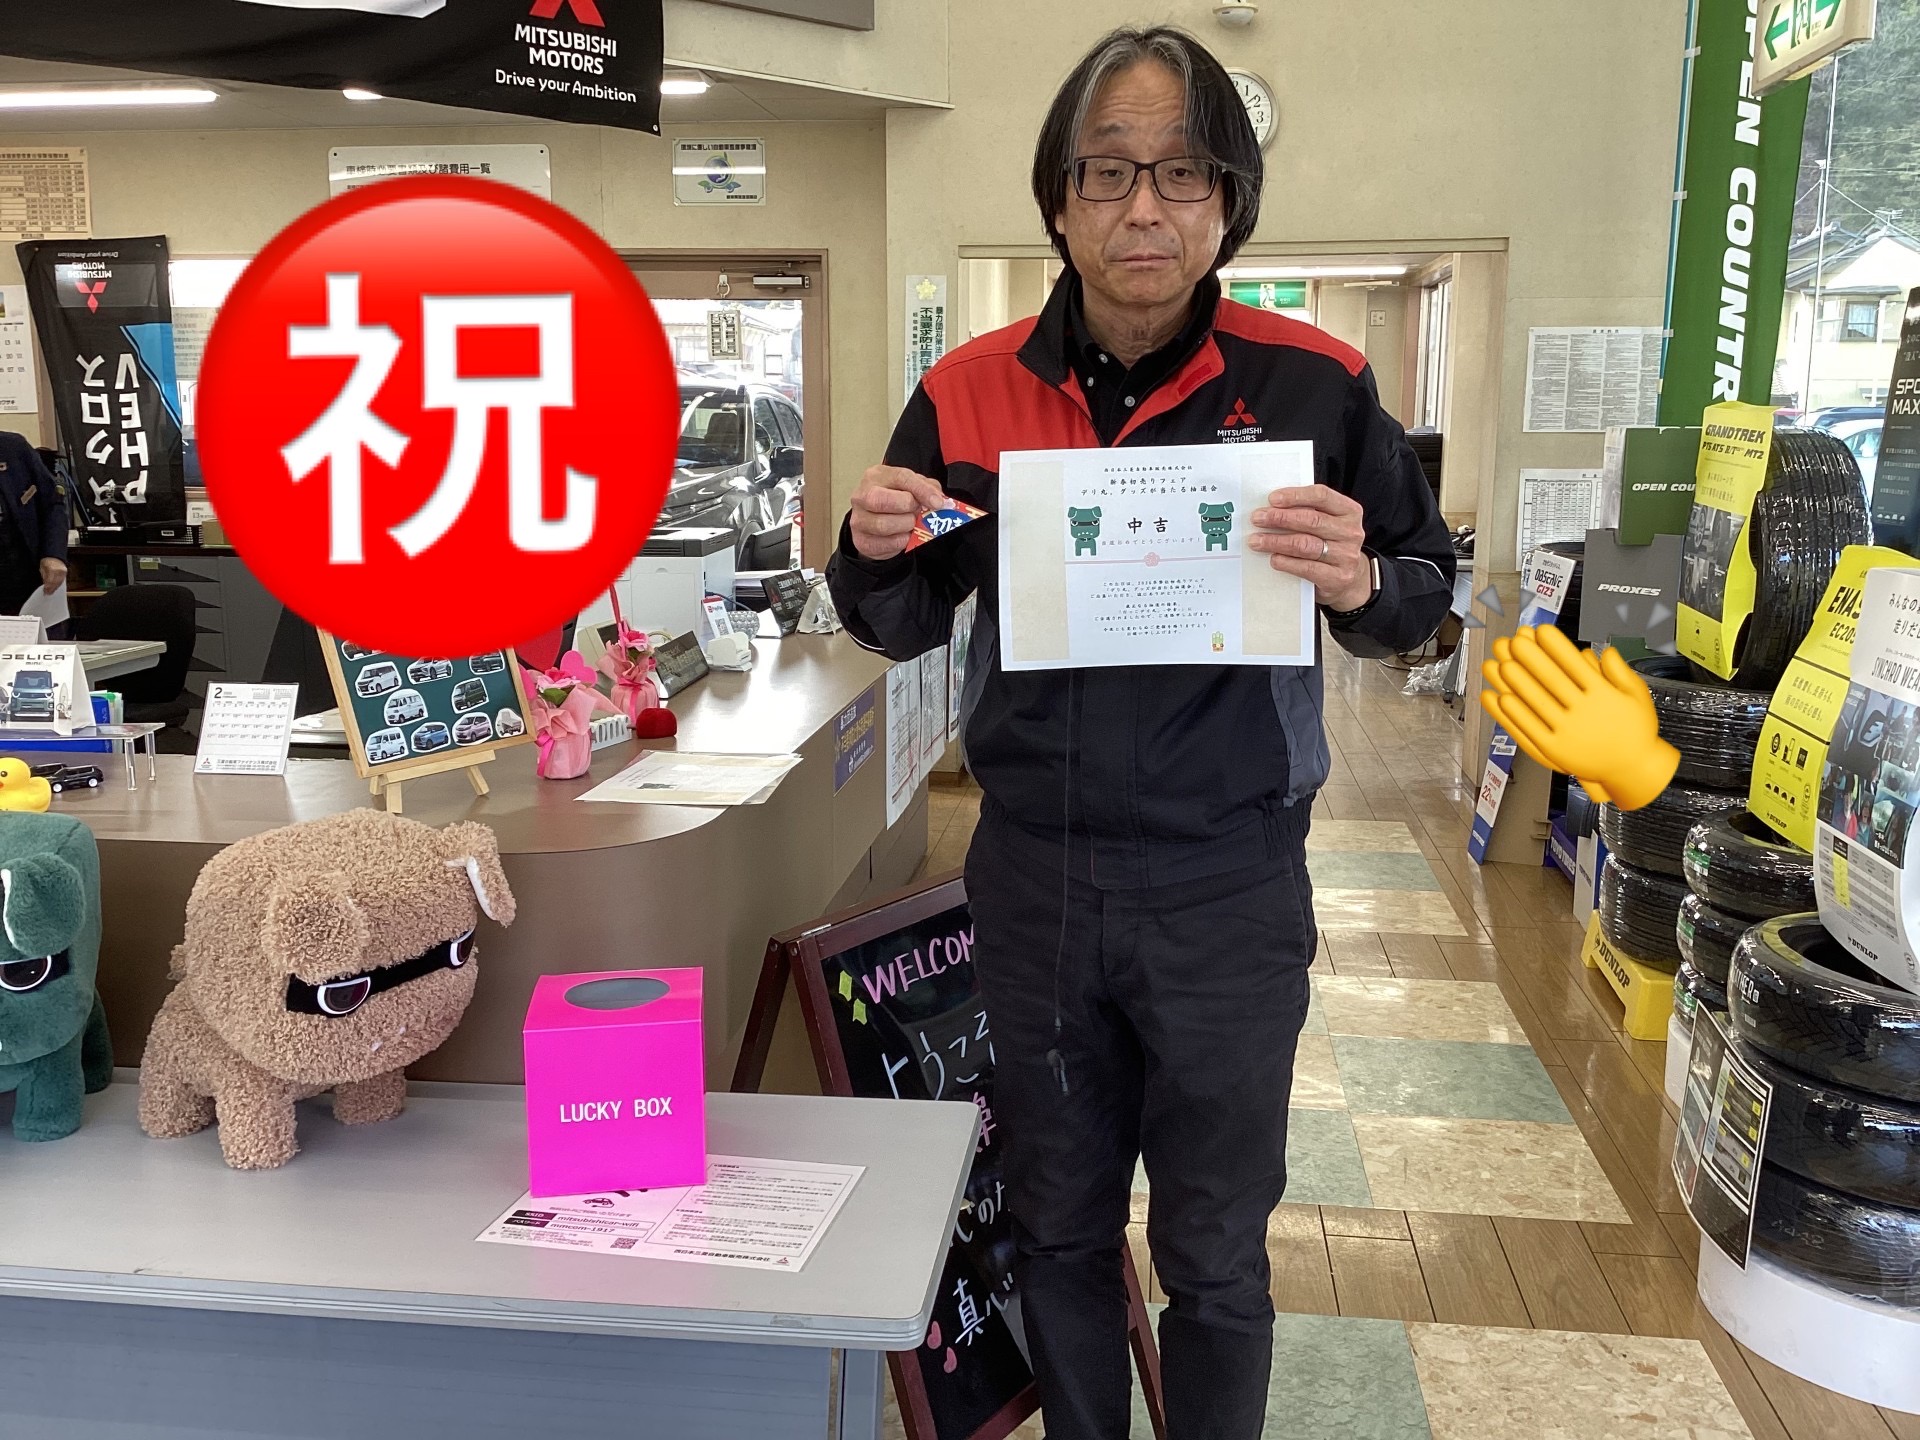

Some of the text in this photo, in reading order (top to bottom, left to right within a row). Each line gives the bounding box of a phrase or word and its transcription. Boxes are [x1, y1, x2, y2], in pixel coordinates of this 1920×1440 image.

[514, 23, 617, 57] MITSUBISHI
[529, 47, 604, 75] MOTORS
[494, 69, 637, 103] Drive your Ambition
[1256, 110, 1264, 123] 3
[67, 270, 112, 279] MITSUBISHI
[114, 353, 150, 504] PHEV
[1216, 426, 1262, 437] MITSUBISHI
[1705, 424, 1766, 444] GRANDTREK
[76, 353, 115, 525] スクロス
[1222, 434, 1257, 444] MOTORS
[1743, 448, 1765, 460] MT2
[1110, 476, 1187, 486] 新春初売りフェア
[1632, 483, 1697, 492] OPEN COU
[1126, 516, 1169, 535] 中吉
[1534, 568, 1564, 589] OBSERVE
[1597, 583, 1662, 596] PROXES
[1, 653, 66, 661] DELICA
[1871, 656, 1920, 693] SYNCHRO WEA
[213, 686, 223, 699] 2
[1851, 938, 1880, 962] DUNLOP
[1599, 941, 1631, 989] DUNLOP
[559, 1096, 674, 1124] LUCKY BOX
[549, 1222, 615, 1234] mmcom-1917
[557, 1215, 640, 1228] mitsubishicar-wifi
